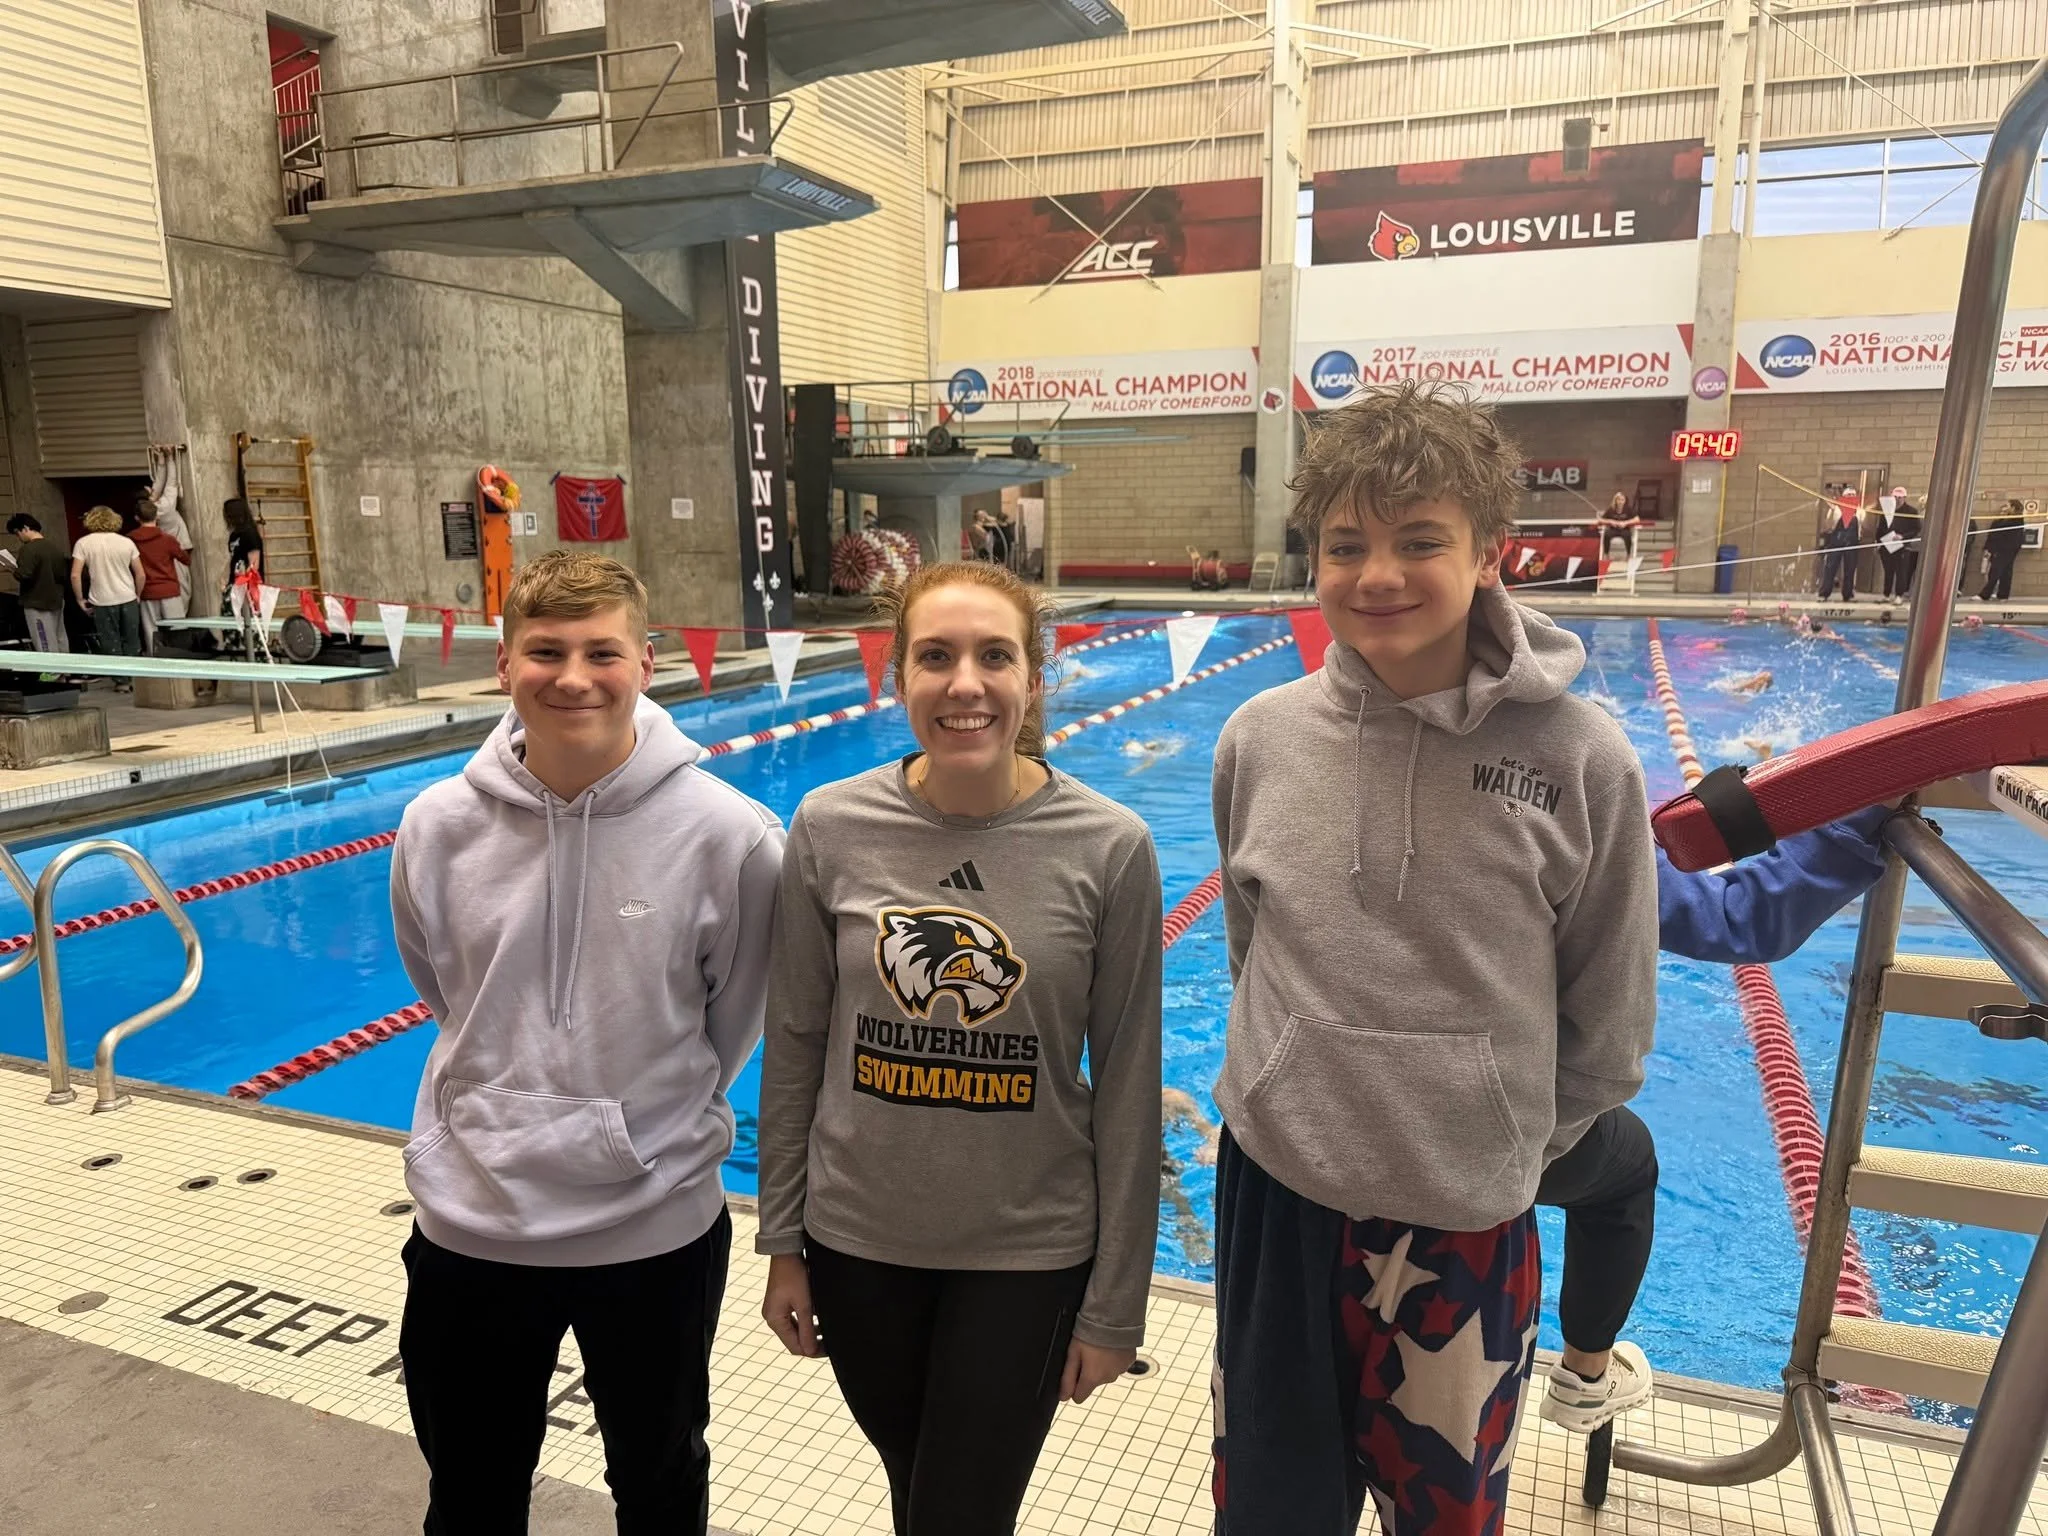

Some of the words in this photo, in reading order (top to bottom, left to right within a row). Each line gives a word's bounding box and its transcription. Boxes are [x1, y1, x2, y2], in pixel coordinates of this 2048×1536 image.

[1430, 210, 1636, 249] LOUISVILLE
[1072, 241, 1159, 272] ACC
[1829, 332, 1880, 347] 2016
[1922, 334, 1945, 343] 200
[1372, 347, 1416, 363] 2017
[1764, 355, 1815, 369] NCAA
[998, 366, 1034, 380] 2018
[1363, 359, 1503, 383] NATIONAL
[1512, 352, 1670, 377] CHAMPION
[1825, 366, 1888, 375] LOUISVILLE
[1894, 364, 1948, 372] SWIMMIN
[992, 379, 1108, 400] NATIONAL
[1115, 372, 1247, 396] CHAMPION
[1315, 373, 1357, 388] NCAA
[1481, 378, 1558, 394] MALLORY
[1562, 375, 1669, 391] COMERFORD
[1696, 383, 1726, 393] NCAA
[1091, 399, 1155, 412] MALLORY
[1161, 394, 1252, 410] COMERFORD
[741, 276, 774, 552] DIVING
[1674, 432, 1737, 457] 09:40
[1537, 467, 1580, 484] LAB
[1500, 757, 1525, 771] let's
[1527, 767, 1542, 777] go
[1473, 763, 1562, 815] WALDEN
[856, 1013, 1039, 1061] WOLVERINES
[858, 1055, 1033, 1104] SWIMMING
[161, 1280, 388, 1357] DEEP
